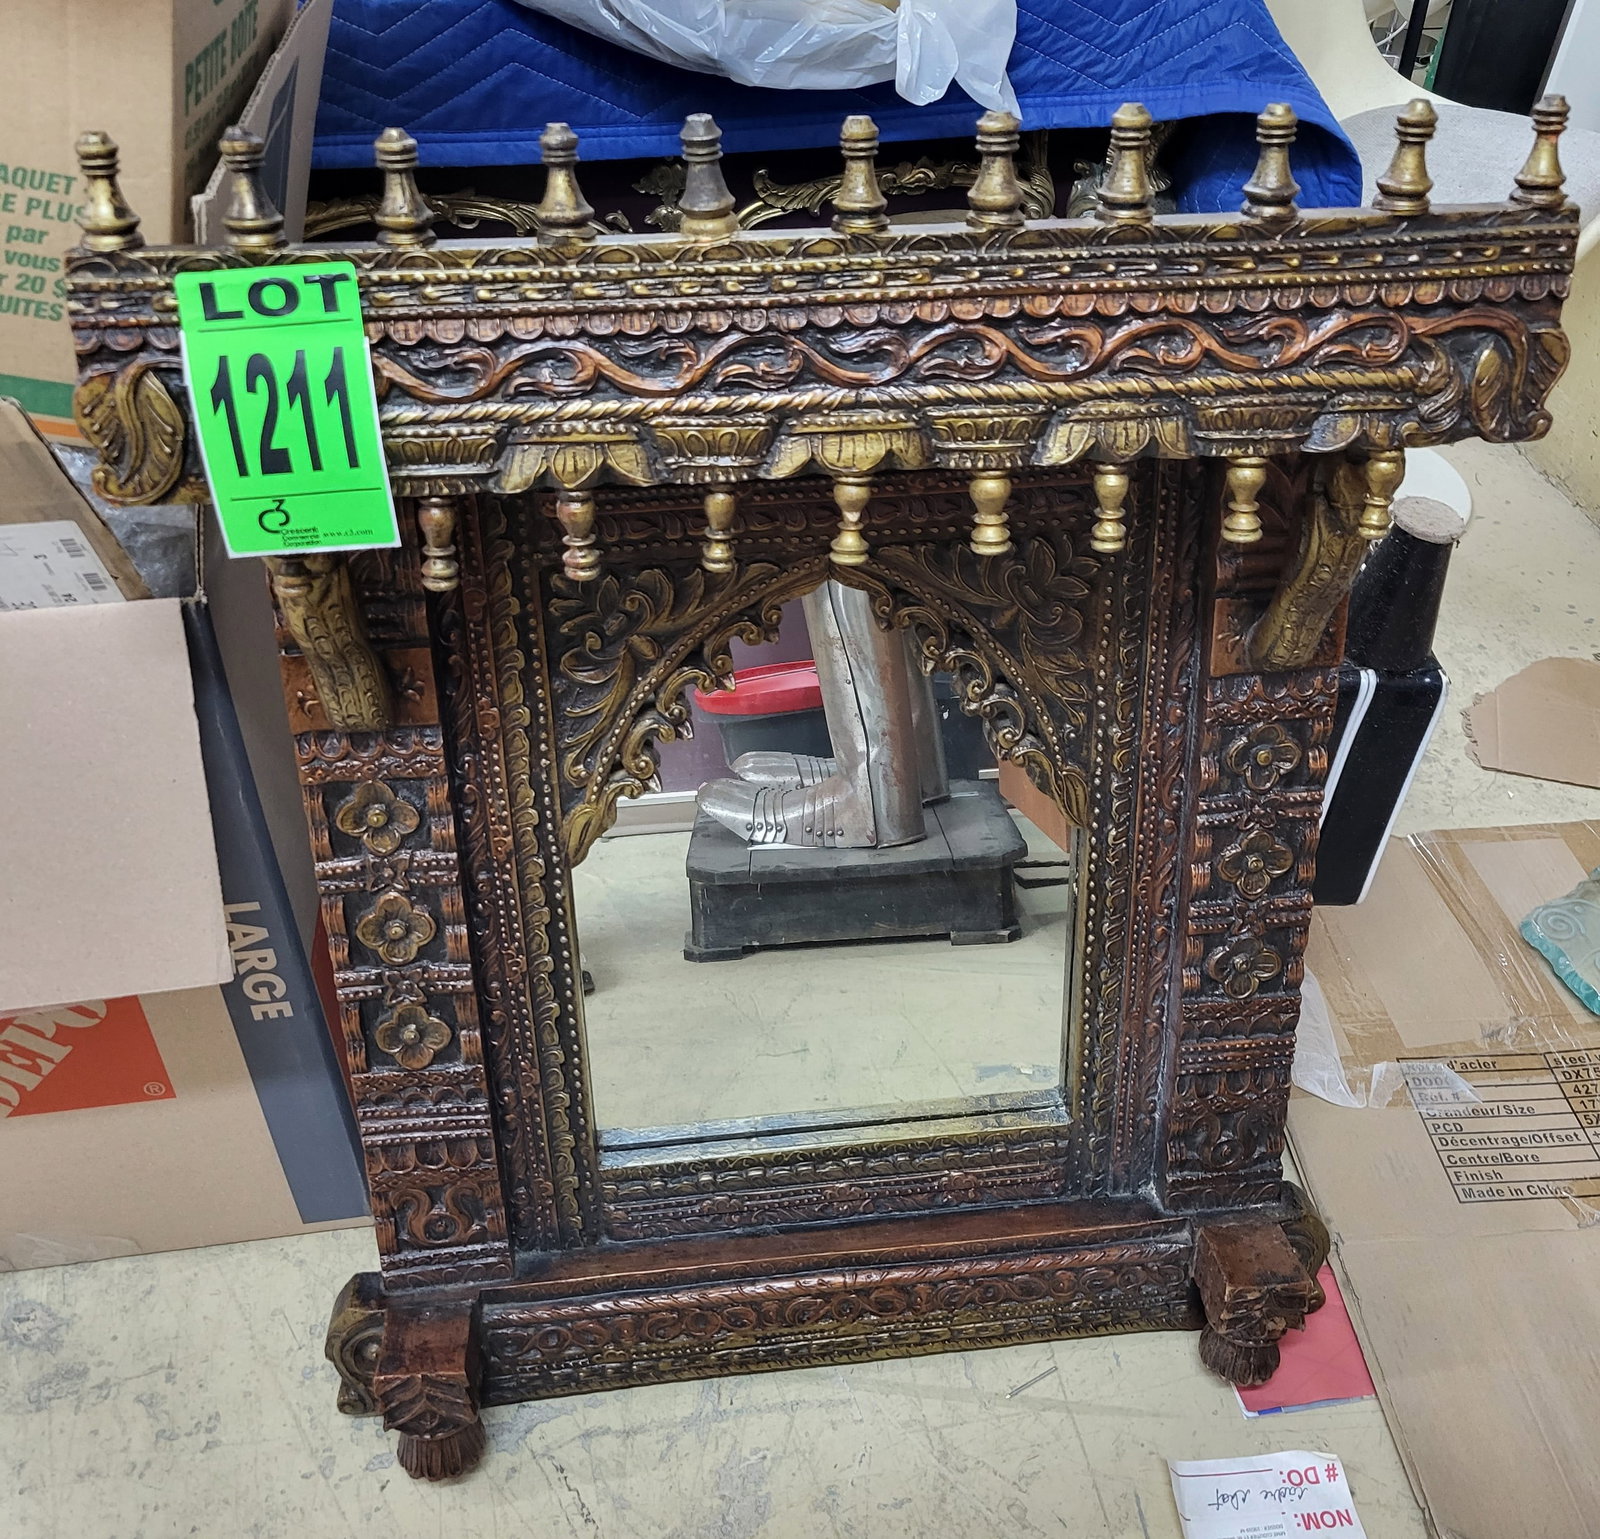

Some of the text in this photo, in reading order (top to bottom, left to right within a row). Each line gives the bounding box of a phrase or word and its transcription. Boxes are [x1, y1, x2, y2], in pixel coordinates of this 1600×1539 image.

[185, 27, 227, 117] PETITE
[0, 193, 17, 213] E
[6, 225, 49, 244] par
[5, 250, 61, 272] vous
[15, 273, 46, 294] 20
[199, 273, 350, 321] LOT
[210, 346, 361, 478] 1211
[223, 901, 294, 1021] LARGE
[1553, 1052, 1592, 1066] steel
[1504, 1103, 1536, 1115] Size
[1432, 1122, 1464, 1133] PCD
[1438, 1131, 1581, 1147] Décentrage/Offset
[1446, 1152, 1540, 1165] Centre/Bore
[1453, 1169, 1504, 1182] Finish
[1462, 1184, 1573, 1199] Made in China
[1279, 1463, 1339, 1486] # DO:
[1294, 1508, 1354, 1531] NOM:
